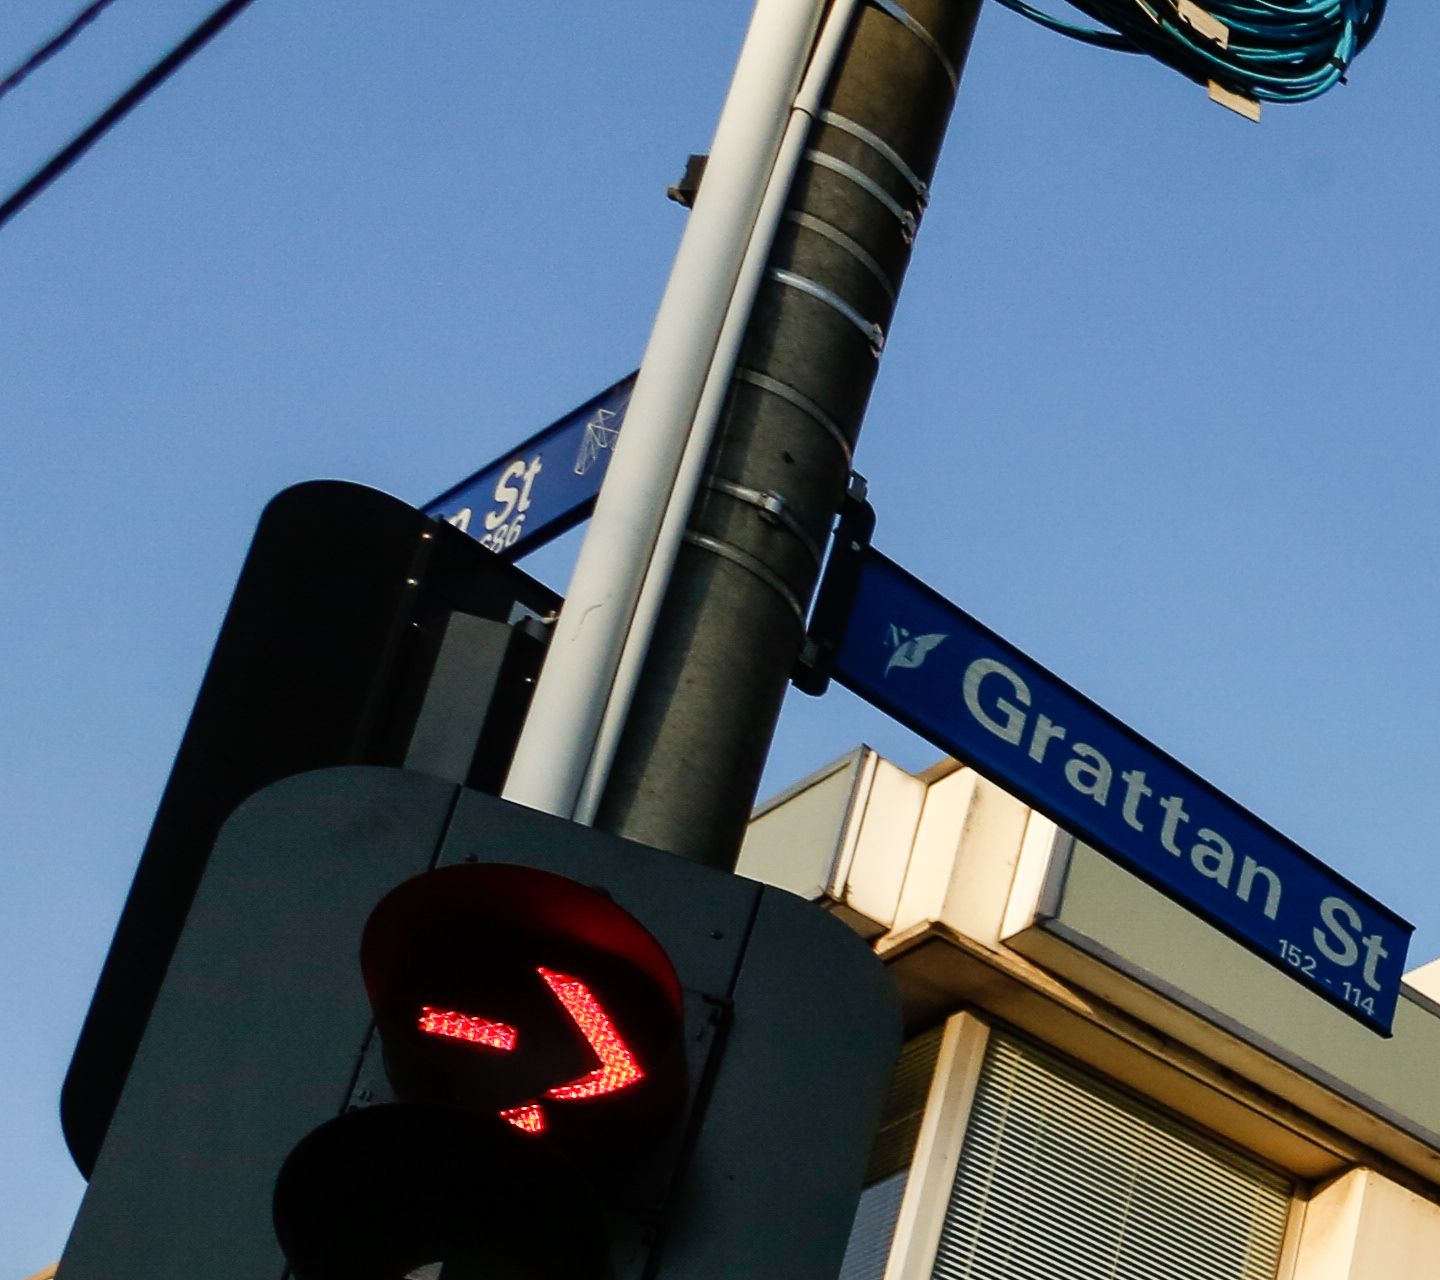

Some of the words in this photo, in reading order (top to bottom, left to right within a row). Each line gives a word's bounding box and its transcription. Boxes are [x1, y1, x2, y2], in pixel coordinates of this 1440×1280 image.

[485, 453, 543, 530] St
[962, 656, 1284, 921] Grattan
[1312, 897, 1389, 993] St
[1277, 936, 1318, 978] 152
[1340, 979, 1377, 1018] 114
